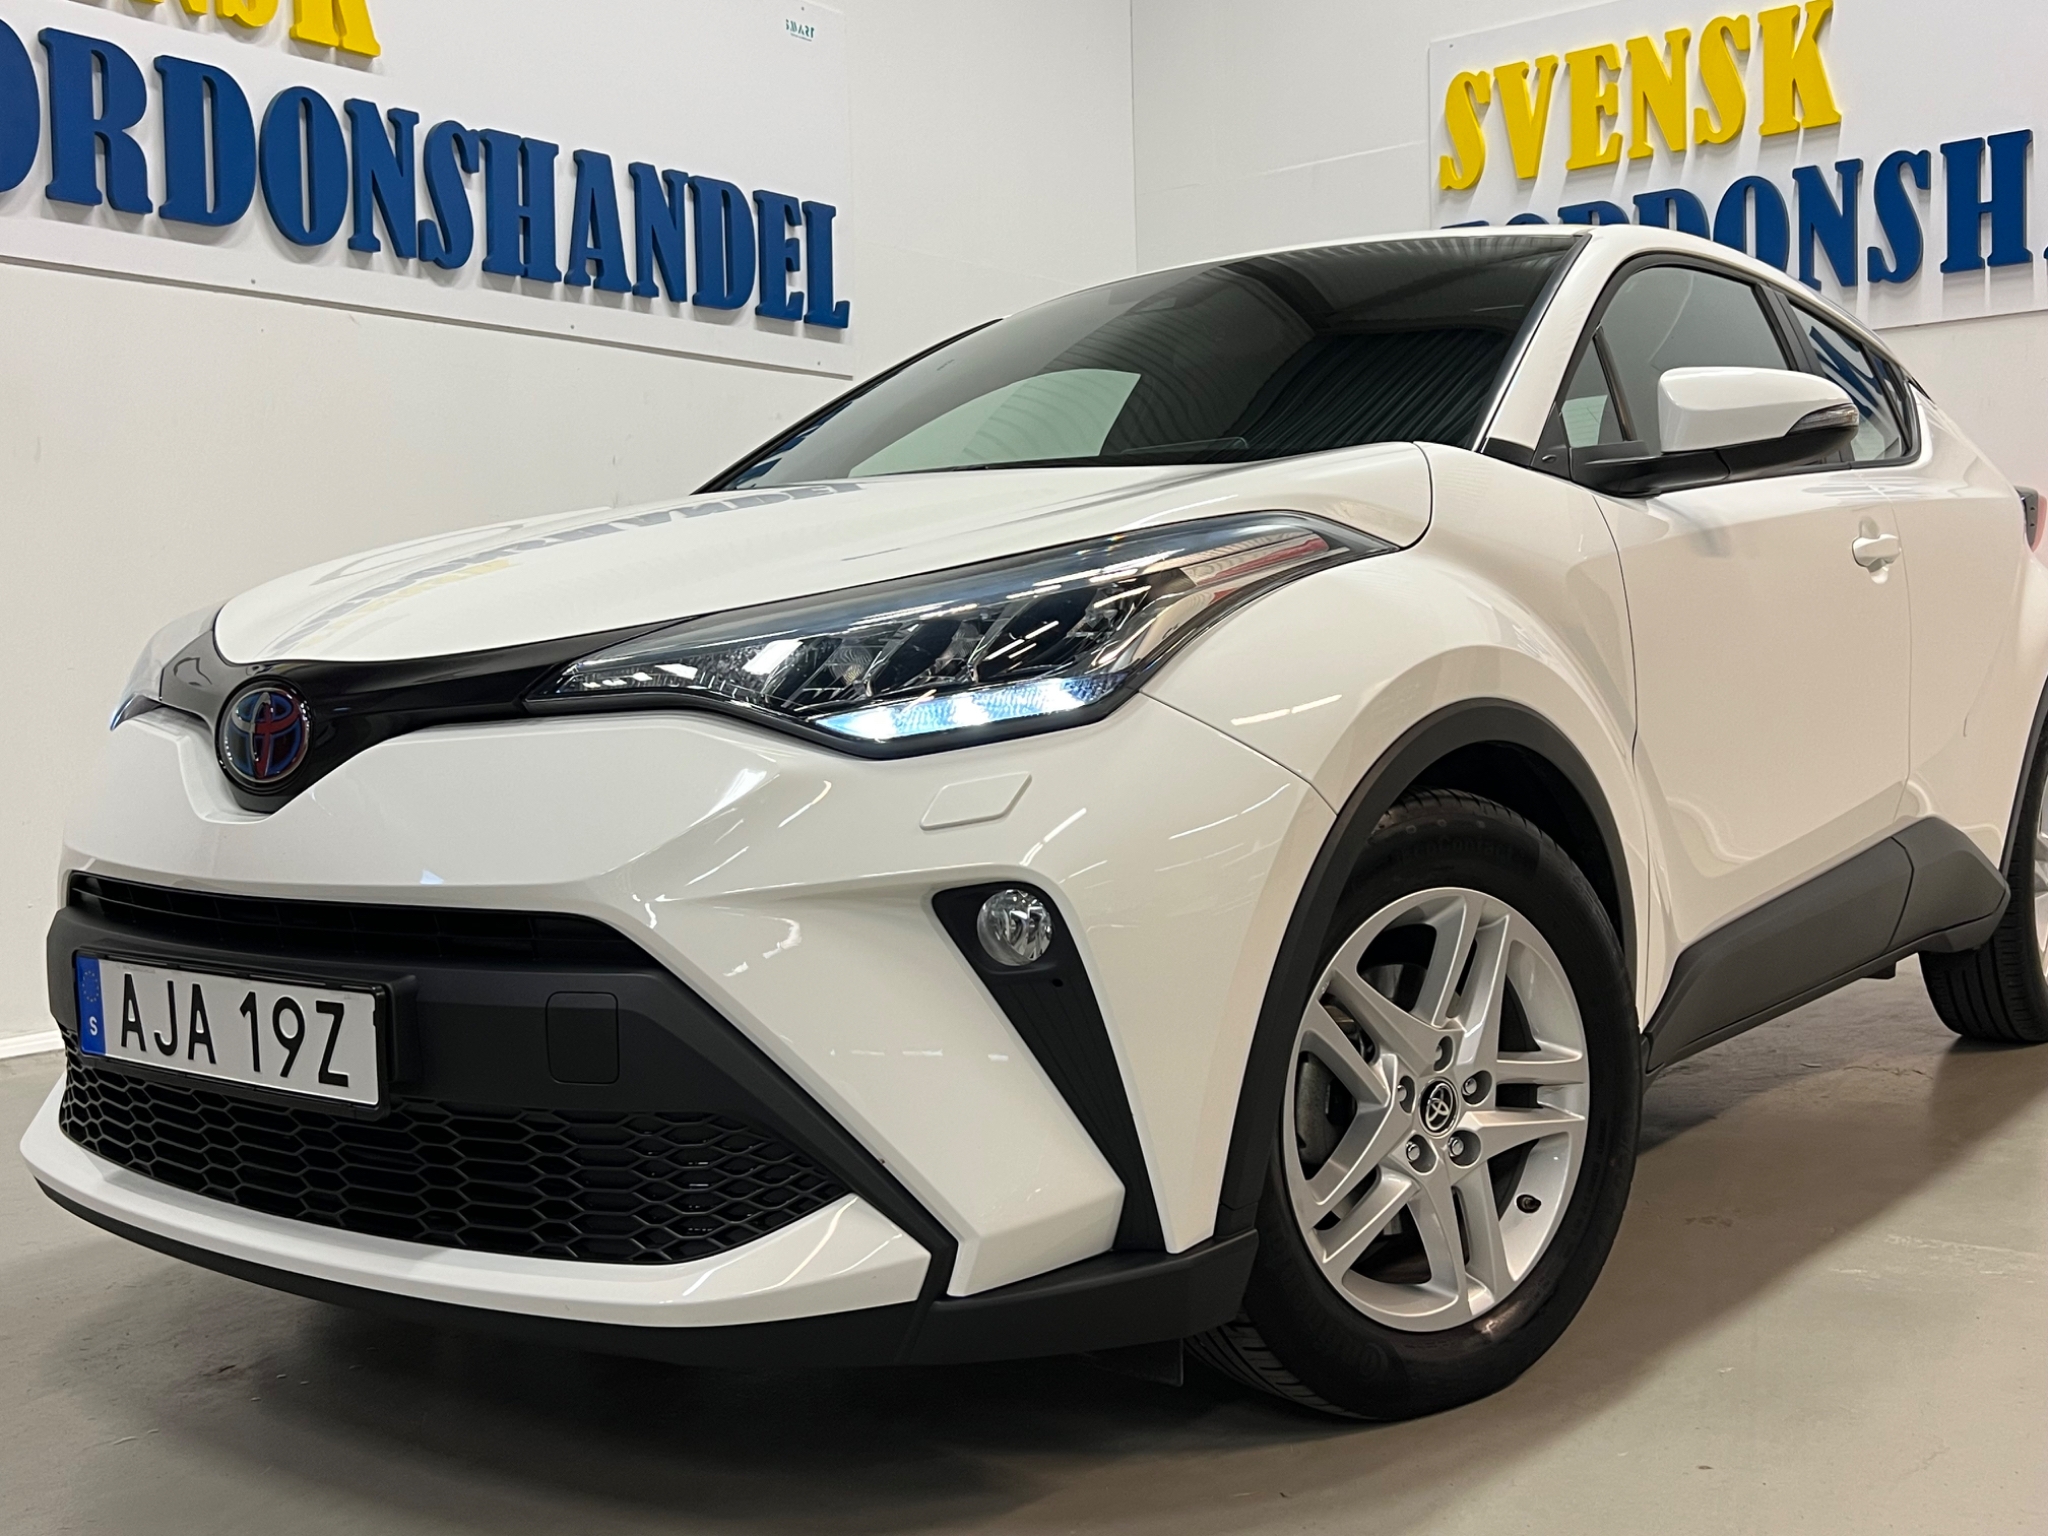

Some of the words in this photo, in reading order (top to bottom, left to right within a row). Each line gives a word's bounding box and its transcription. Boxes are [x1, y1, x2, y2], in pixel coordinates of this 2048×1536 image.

[1439, 0, 1842, 190] SVENSK
[89, 1016, 98, 1036] S
[121, 973, 217, 1065] AJA
[239, 991, 349, 1088] 19Z
